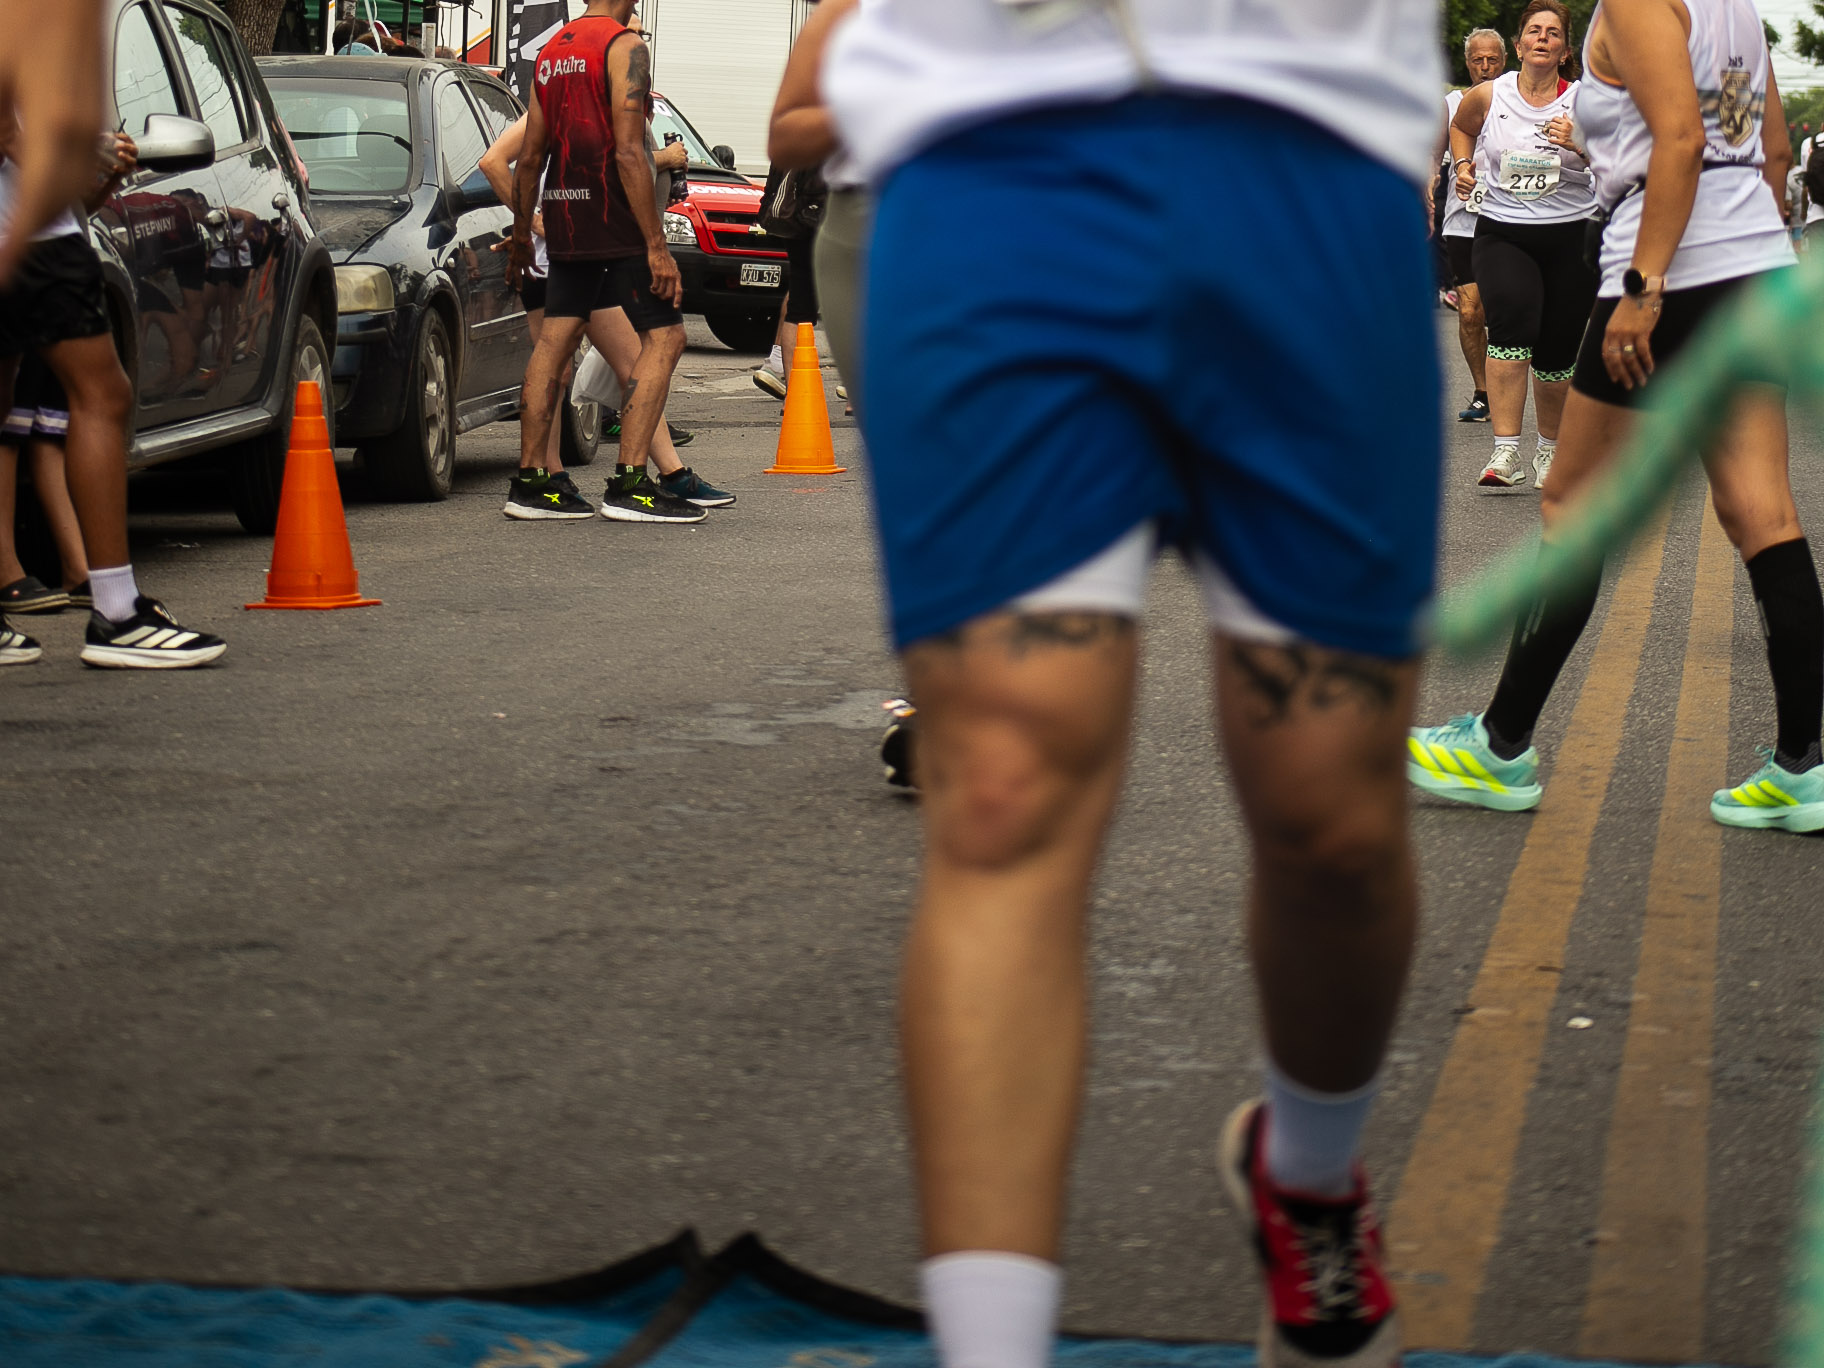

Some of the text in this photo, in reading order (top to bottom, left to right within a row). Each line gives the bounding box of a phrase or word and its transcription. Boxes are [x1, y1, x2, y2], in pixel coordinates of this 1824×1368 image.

[553, 55, 586, 77] Atilra
[1509, 173, 1547, 190] 278
[134, 217, 172, 240] STEPWAY
[763, 270, 779, 283] 575
